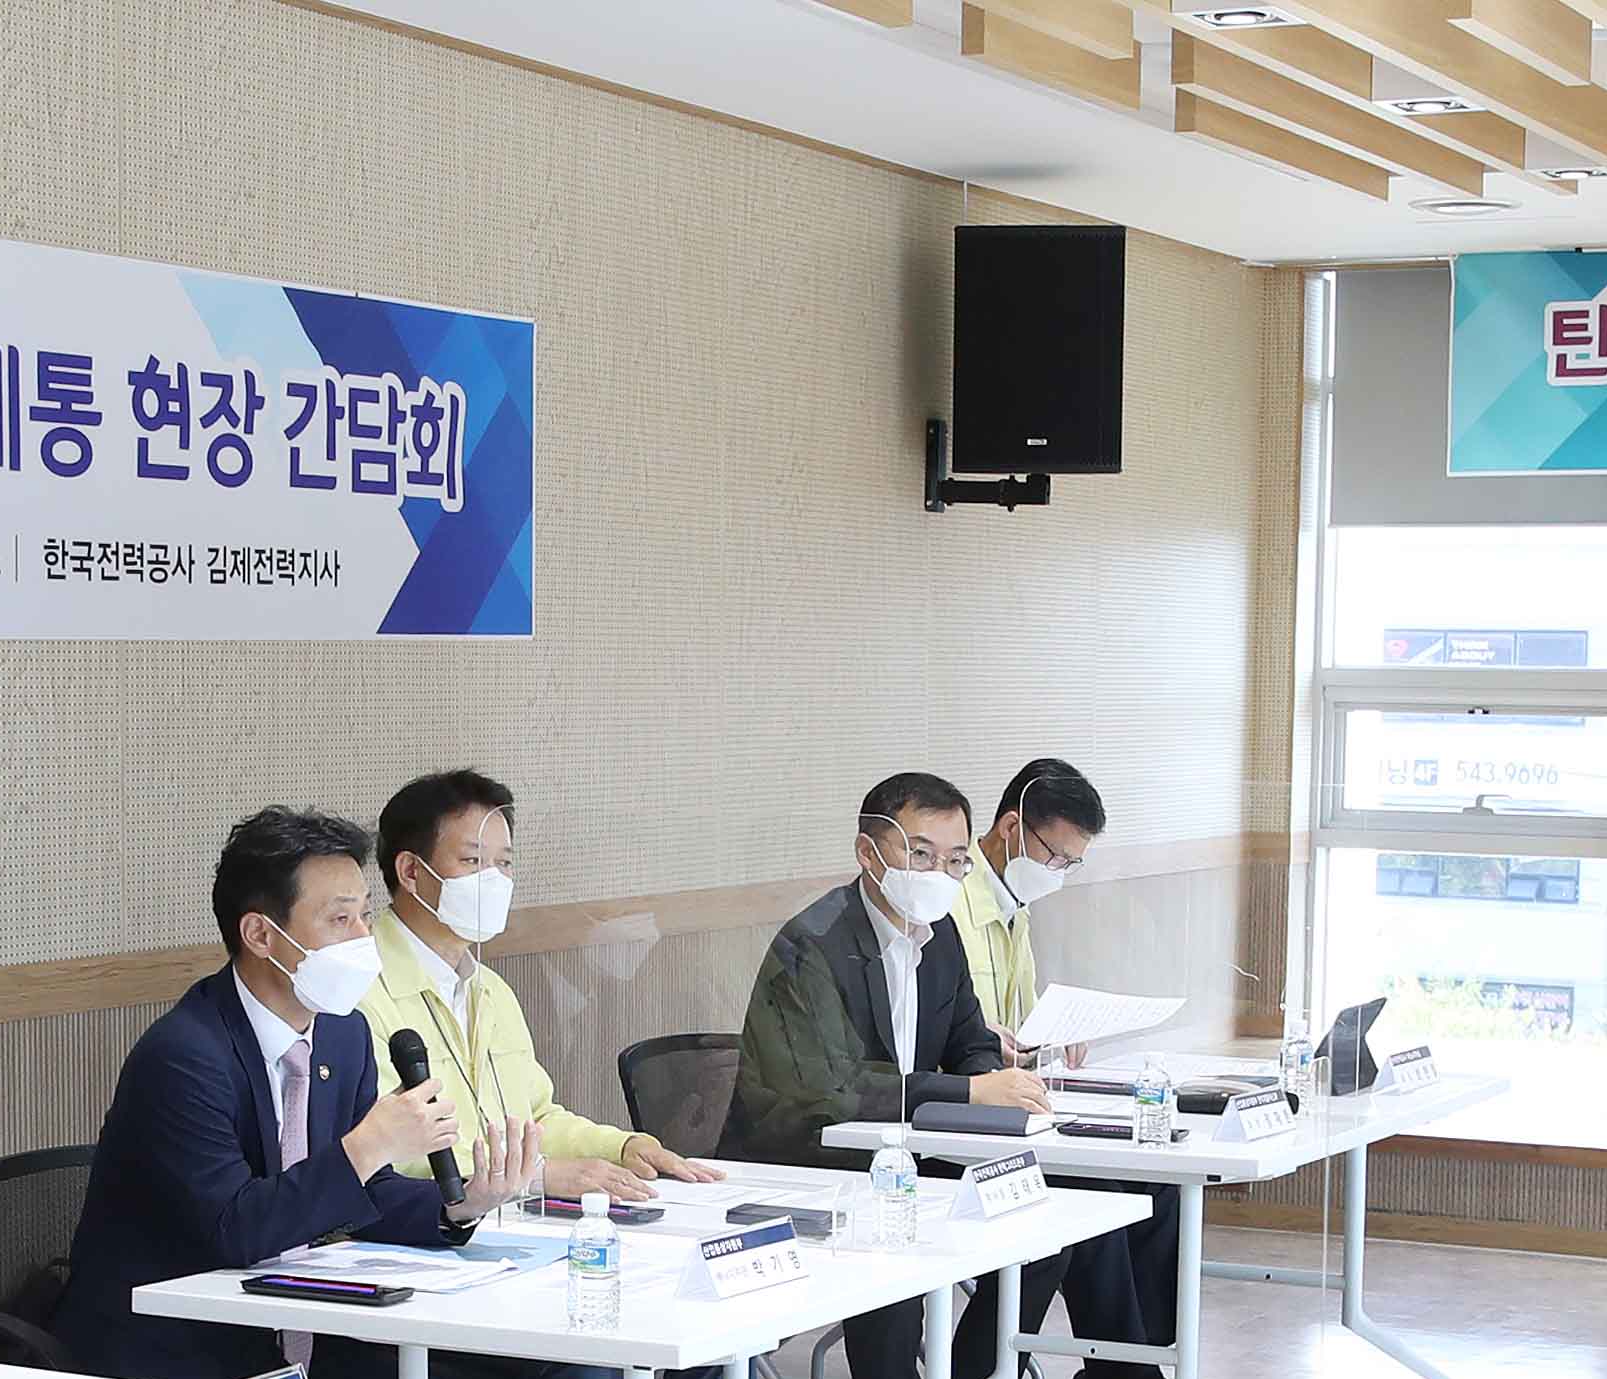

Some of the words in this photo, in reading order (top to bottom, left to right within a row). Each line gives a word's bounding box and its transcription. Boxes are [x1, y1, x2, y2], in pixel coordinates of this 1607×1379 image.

[130, 354, 266, 488] 현장
[283, 374, 464, 500] 간담회
[42, 537, 197, 586] 한국전력공사
[206, 544, 342, 589] 김제전력지사
